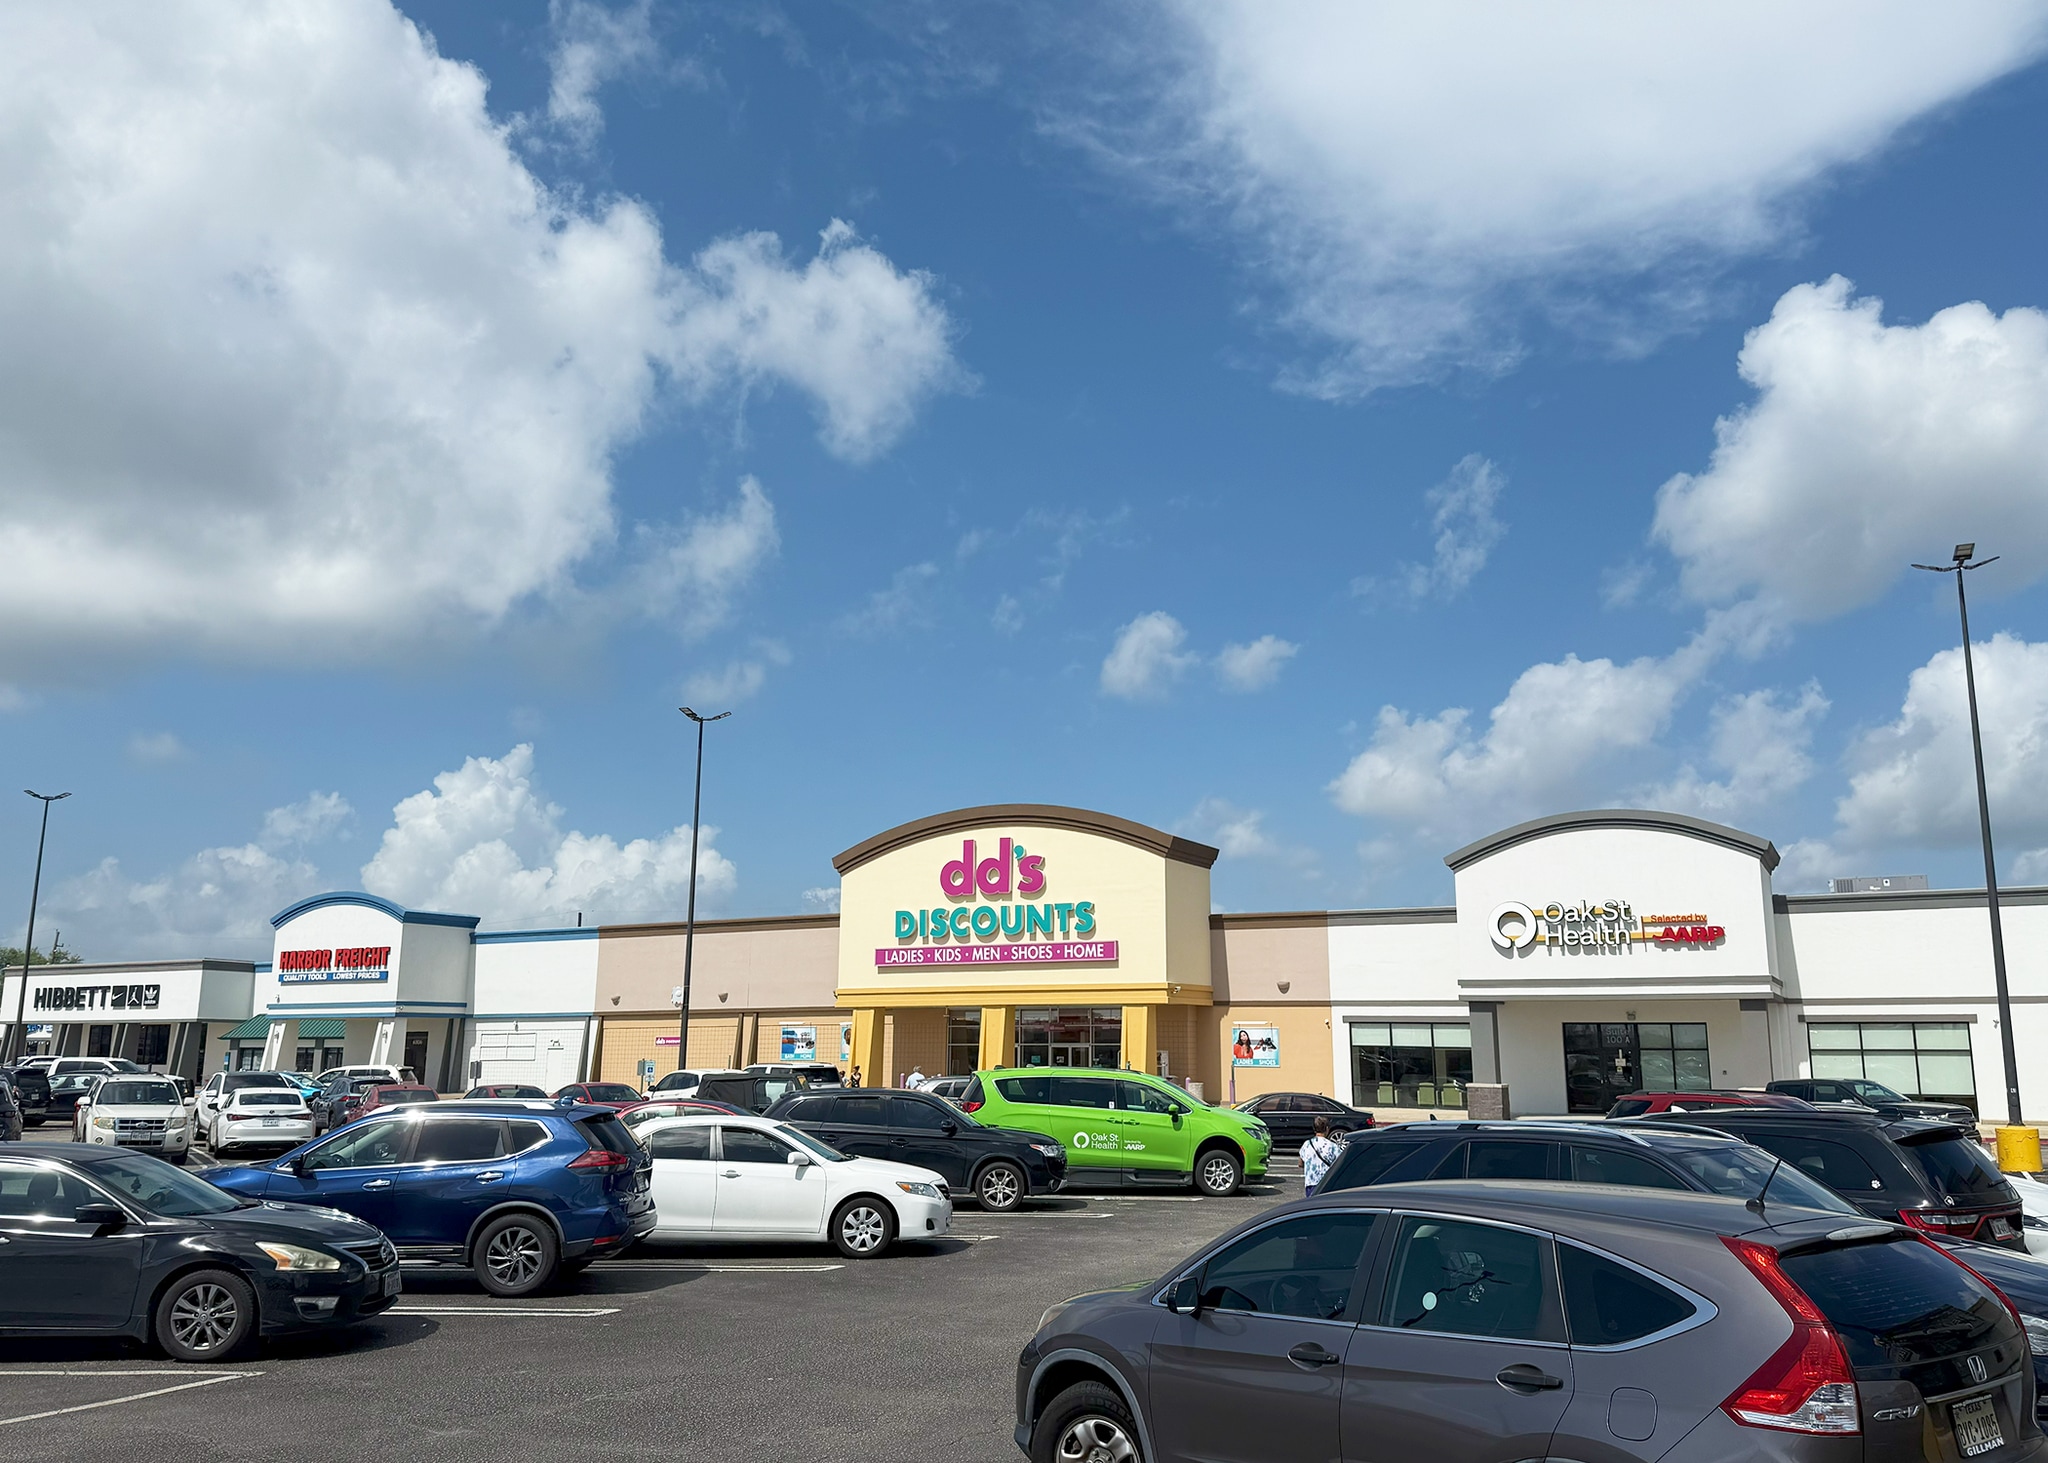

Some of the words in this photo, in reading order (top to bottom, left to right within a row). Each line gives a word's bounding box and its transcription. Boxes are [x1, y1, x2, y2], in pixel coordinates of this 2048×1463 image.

[940, 837, 1044, 896] dd's
[895, 901, 1096, 938] DISCOUNTS
[1542, 900, 1596, 923] Oak
[1601, 899, 1636, 923] St.
[1650, 914, 1692, 923] Selected
[1694, 914, 1707, 924] by
[1544, 924, 1631, 947] Health
[1653, 926, 1726, 943] AARP
[279, 949, 332, 970] HARBOR
[334, 946, 391, 968] FREIGHT
[884, 949, 924, 964] LADIES
[934, 948, 962, 963] KIDS
[972, 947, 1001, 961] MEN
[1011, 945, 1052, 960] SHOES
[1064, 944, 1104, 958] HOME
[333, 972, 357, 980] LOWEST
[33, 985, 111, 1009] HIBBETT
[1606, 1036, 1623, 1044] 100
[1091, 1132, 1108, 1141] Oak
[1091, 1141, 1118, 1150] Health
[1966, 1436, 2005, 1457] GILLMAN
